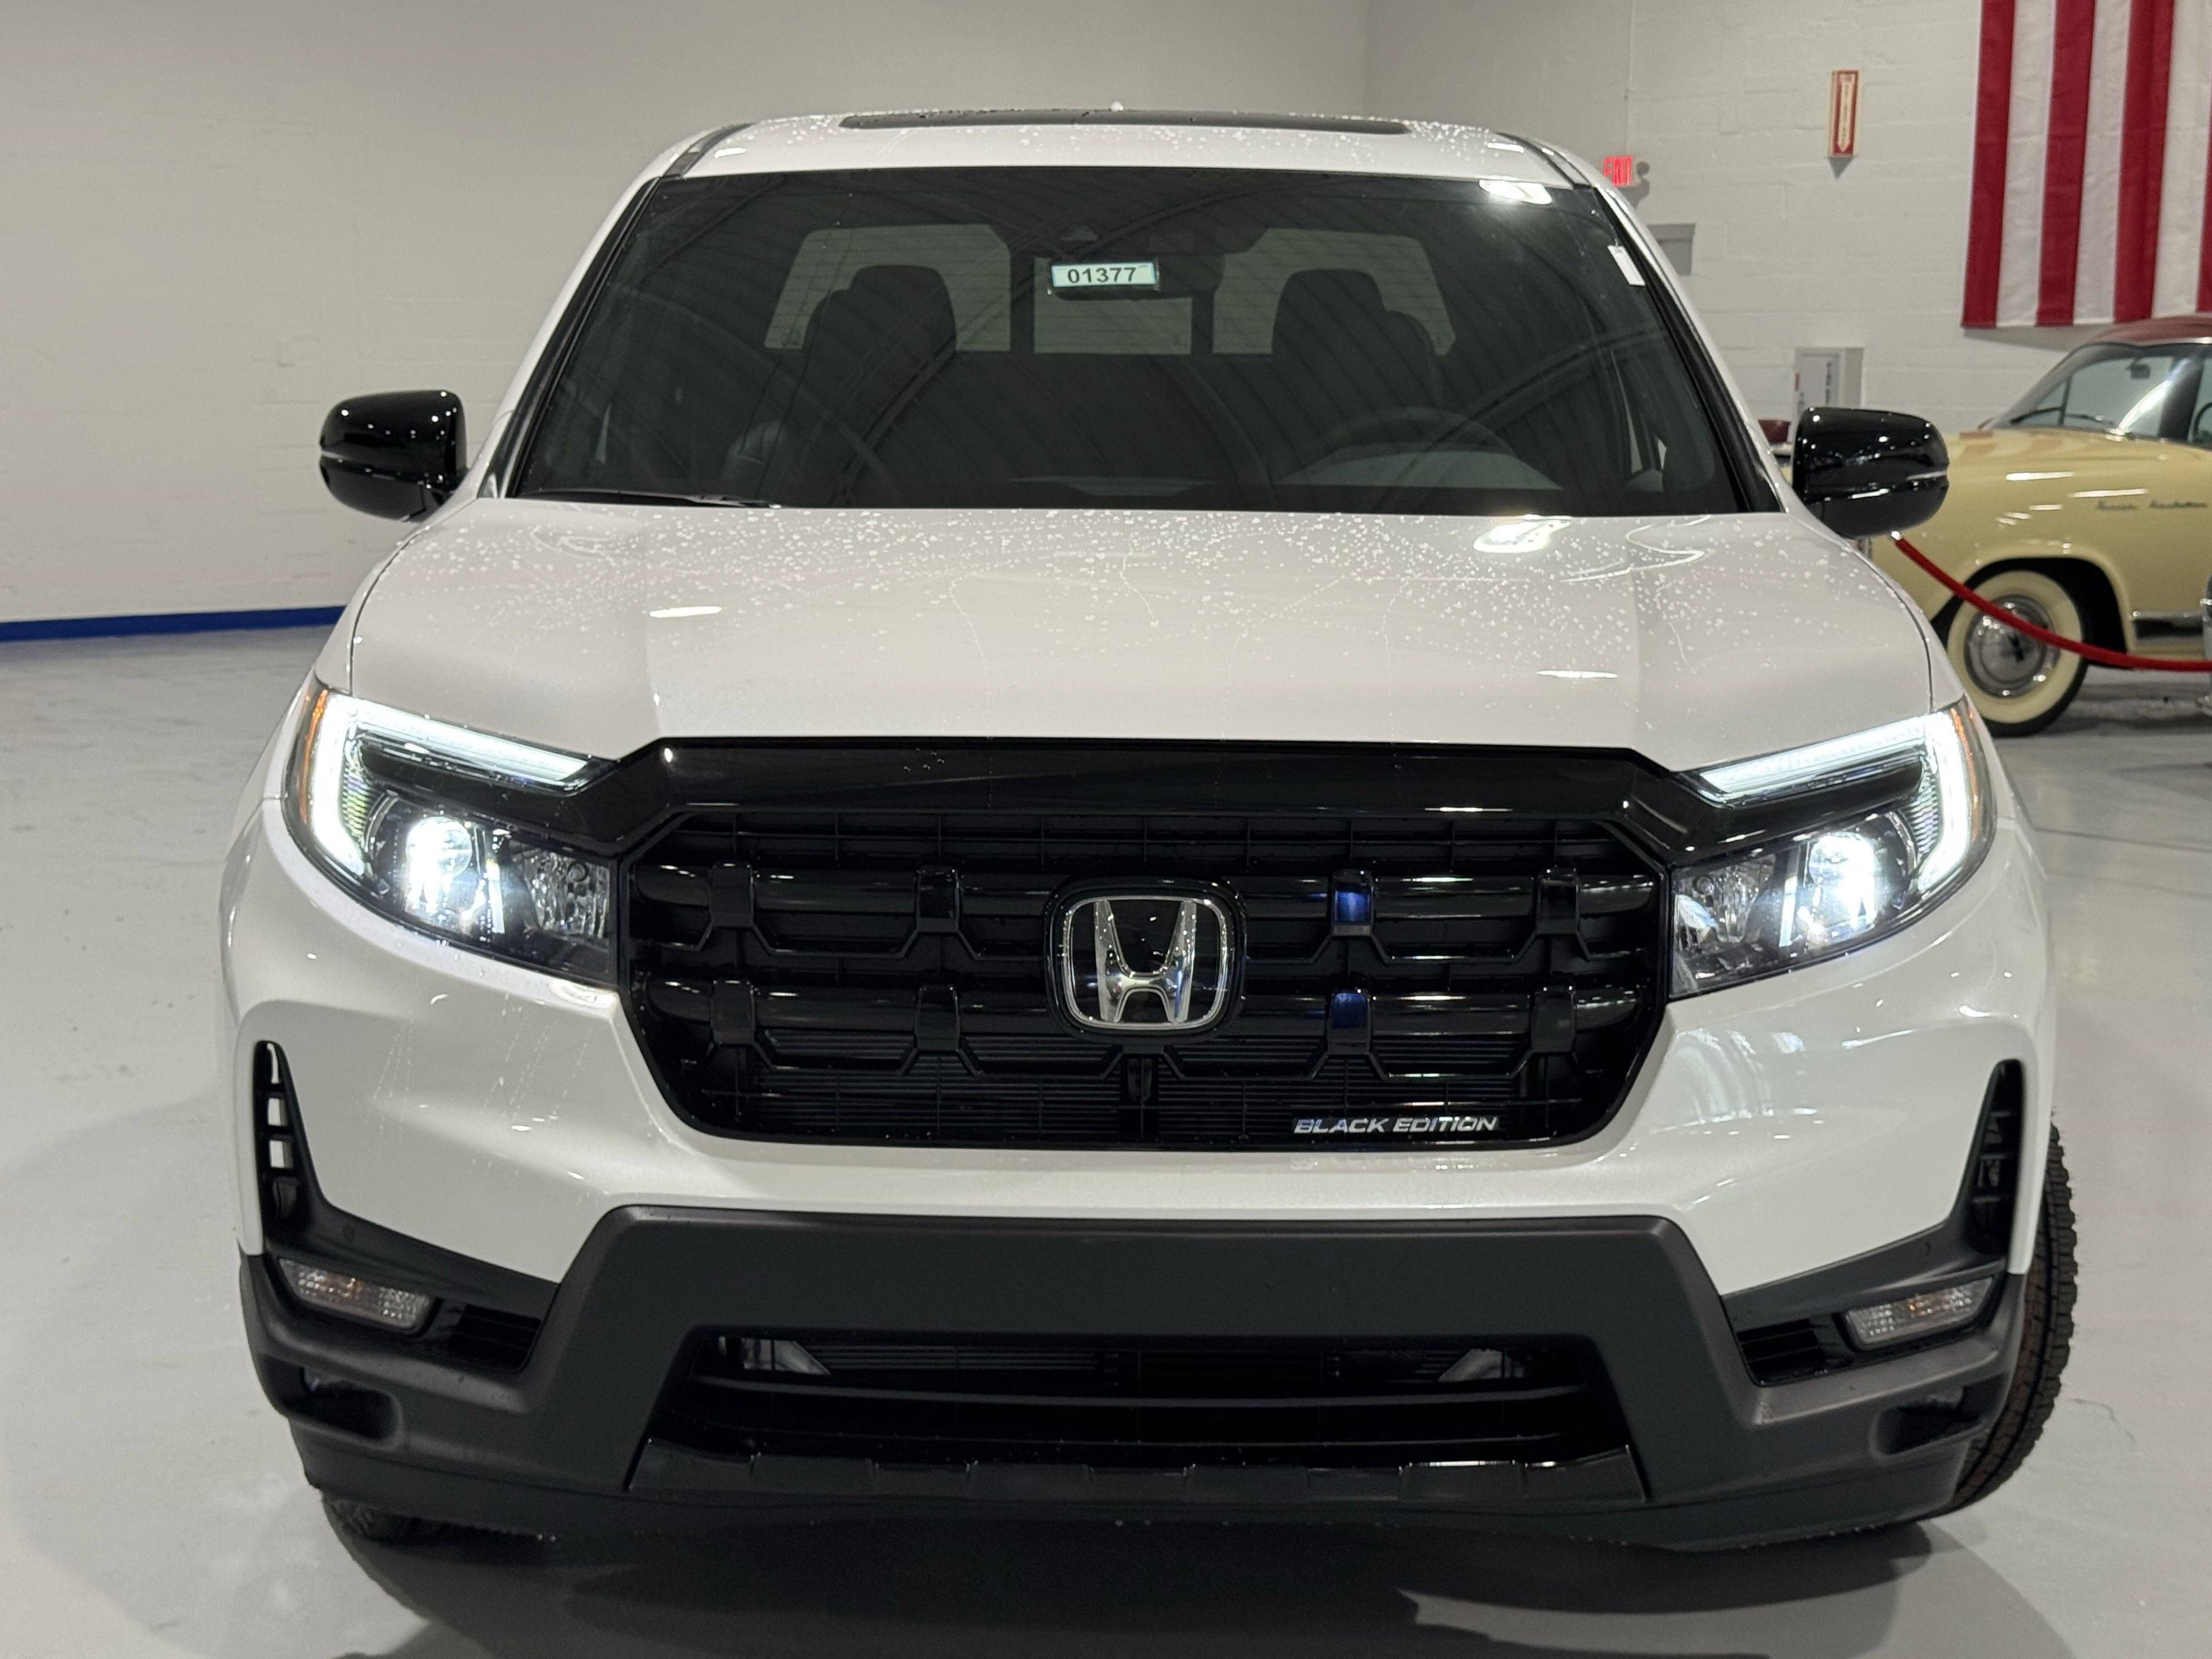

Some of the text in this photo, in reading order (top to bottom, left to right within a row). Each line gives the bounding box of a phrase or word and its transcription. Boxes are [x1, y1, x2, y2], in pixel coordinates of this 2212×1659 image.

[1068, 267, 1136, 283] 01377
[1294, 1116, 1498, 1134] BLACK EDITION
